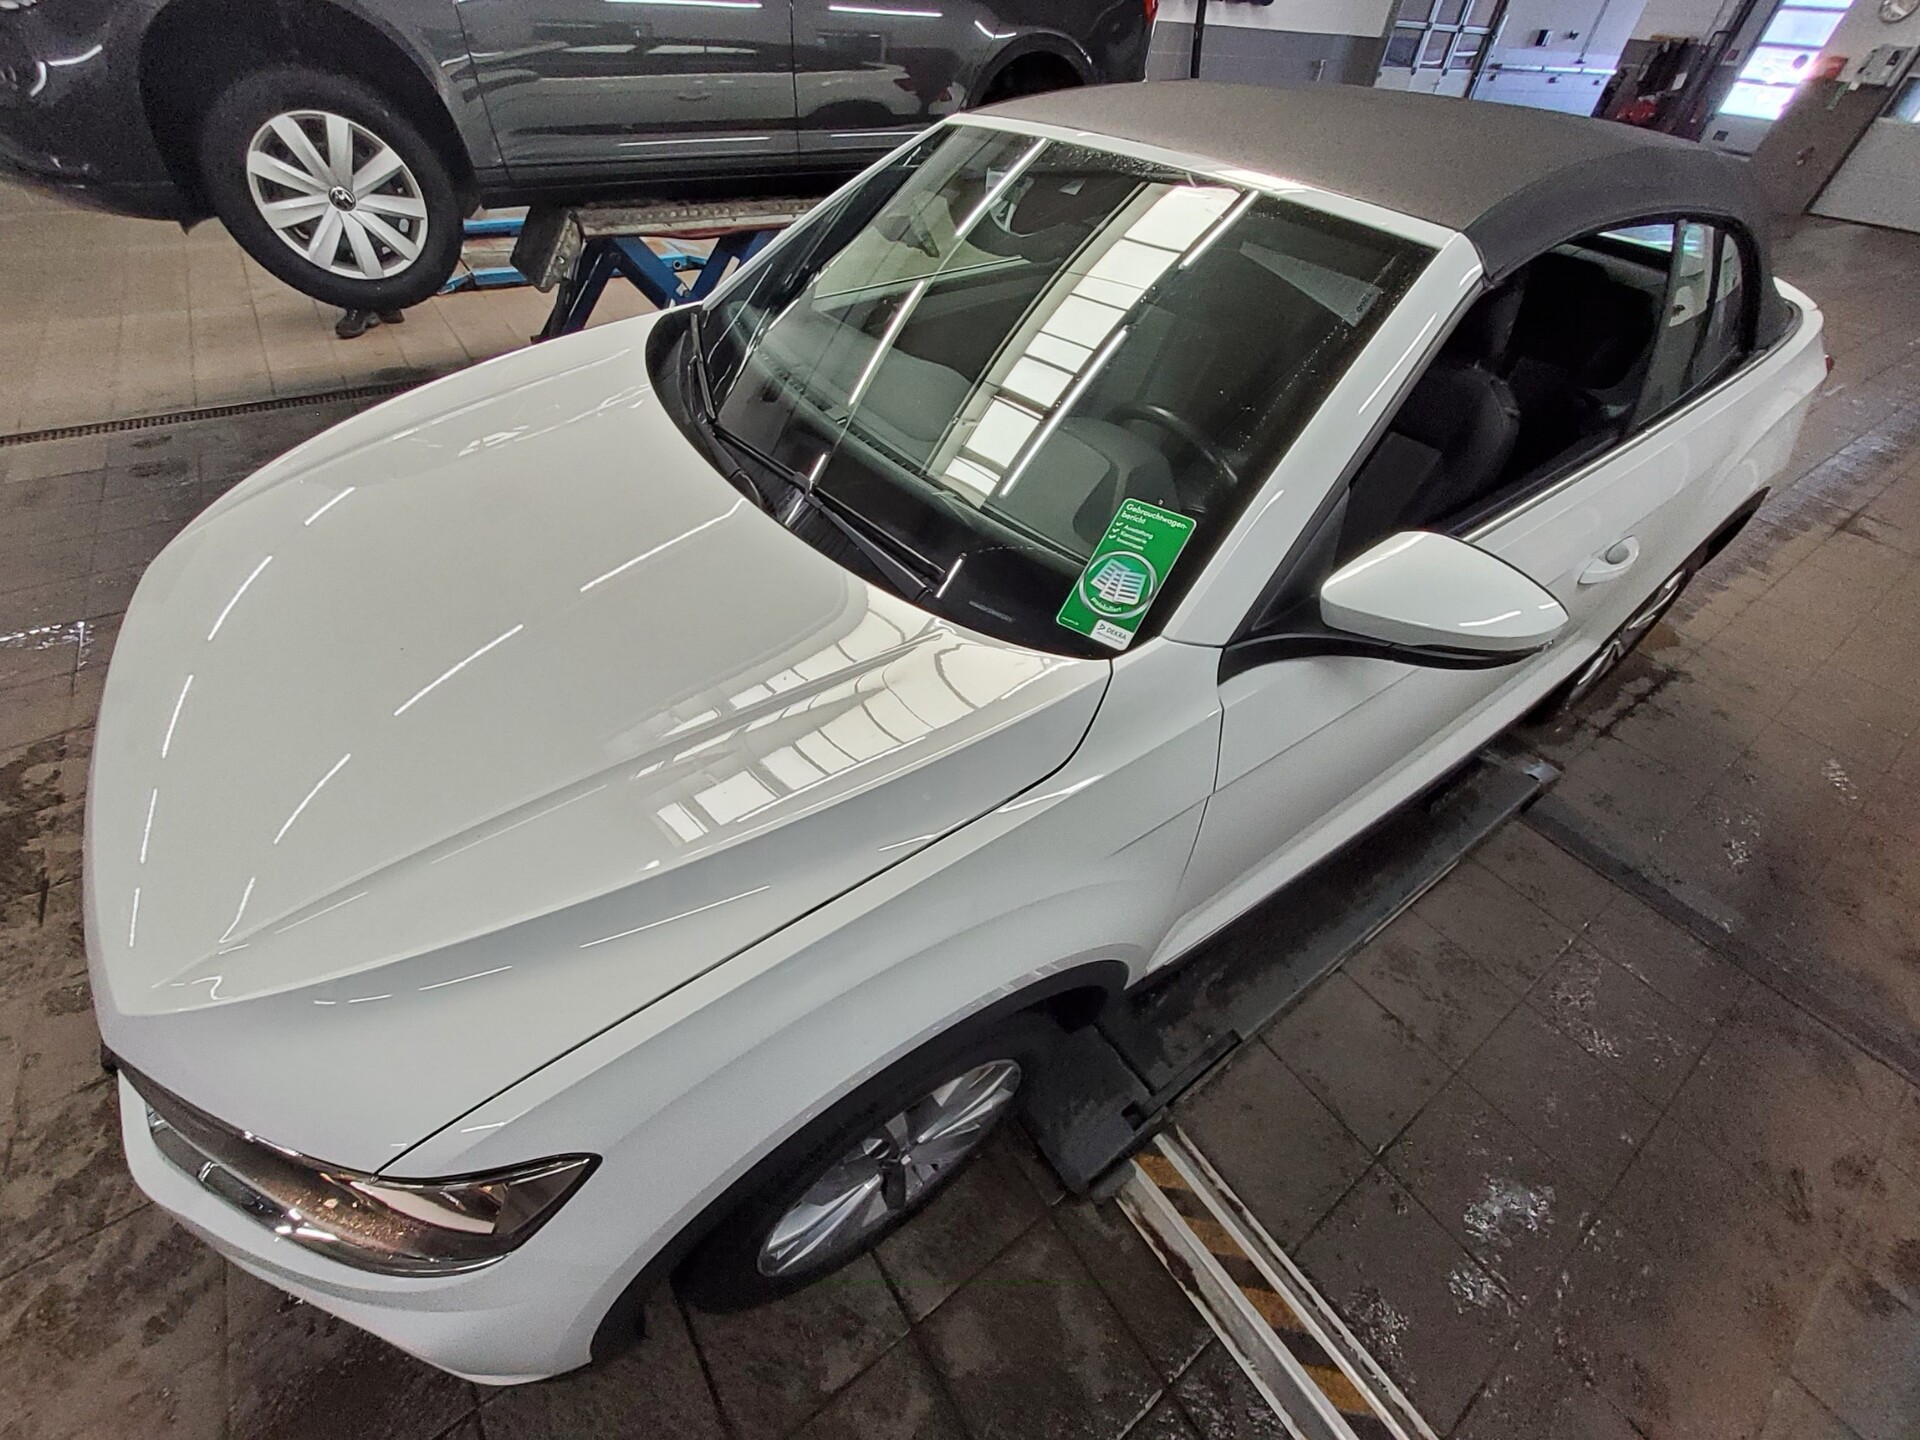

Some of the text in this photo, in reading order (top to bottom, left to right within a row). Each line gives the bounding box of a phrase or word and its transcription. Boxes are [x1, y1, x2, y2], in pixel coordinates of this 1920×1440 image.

[1121, 511, 1146, 525] bericht
[1127, 504, 1187, 530] Gebrauchtwagen-
[1106, 627, 1127, 640] DEKRA
